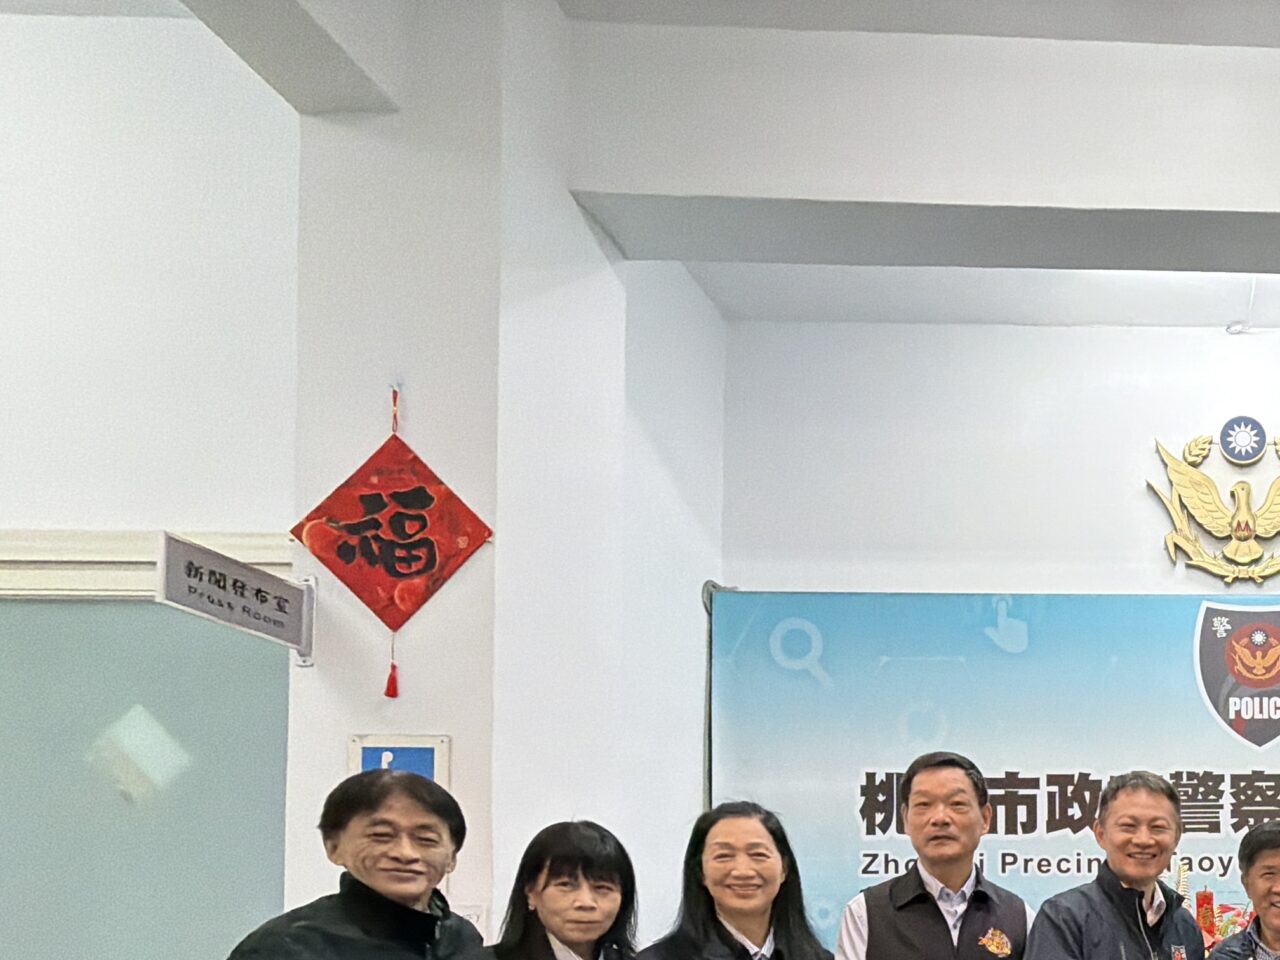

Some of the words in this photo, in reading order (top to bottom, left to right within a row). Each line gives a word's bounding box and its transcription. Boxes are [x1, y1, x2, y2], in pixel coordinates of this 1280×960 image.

[336, 485, 438, 579] 福
[1212, 616, 1233, 639] 警
[1001, 853, 1102, 875] Precin
